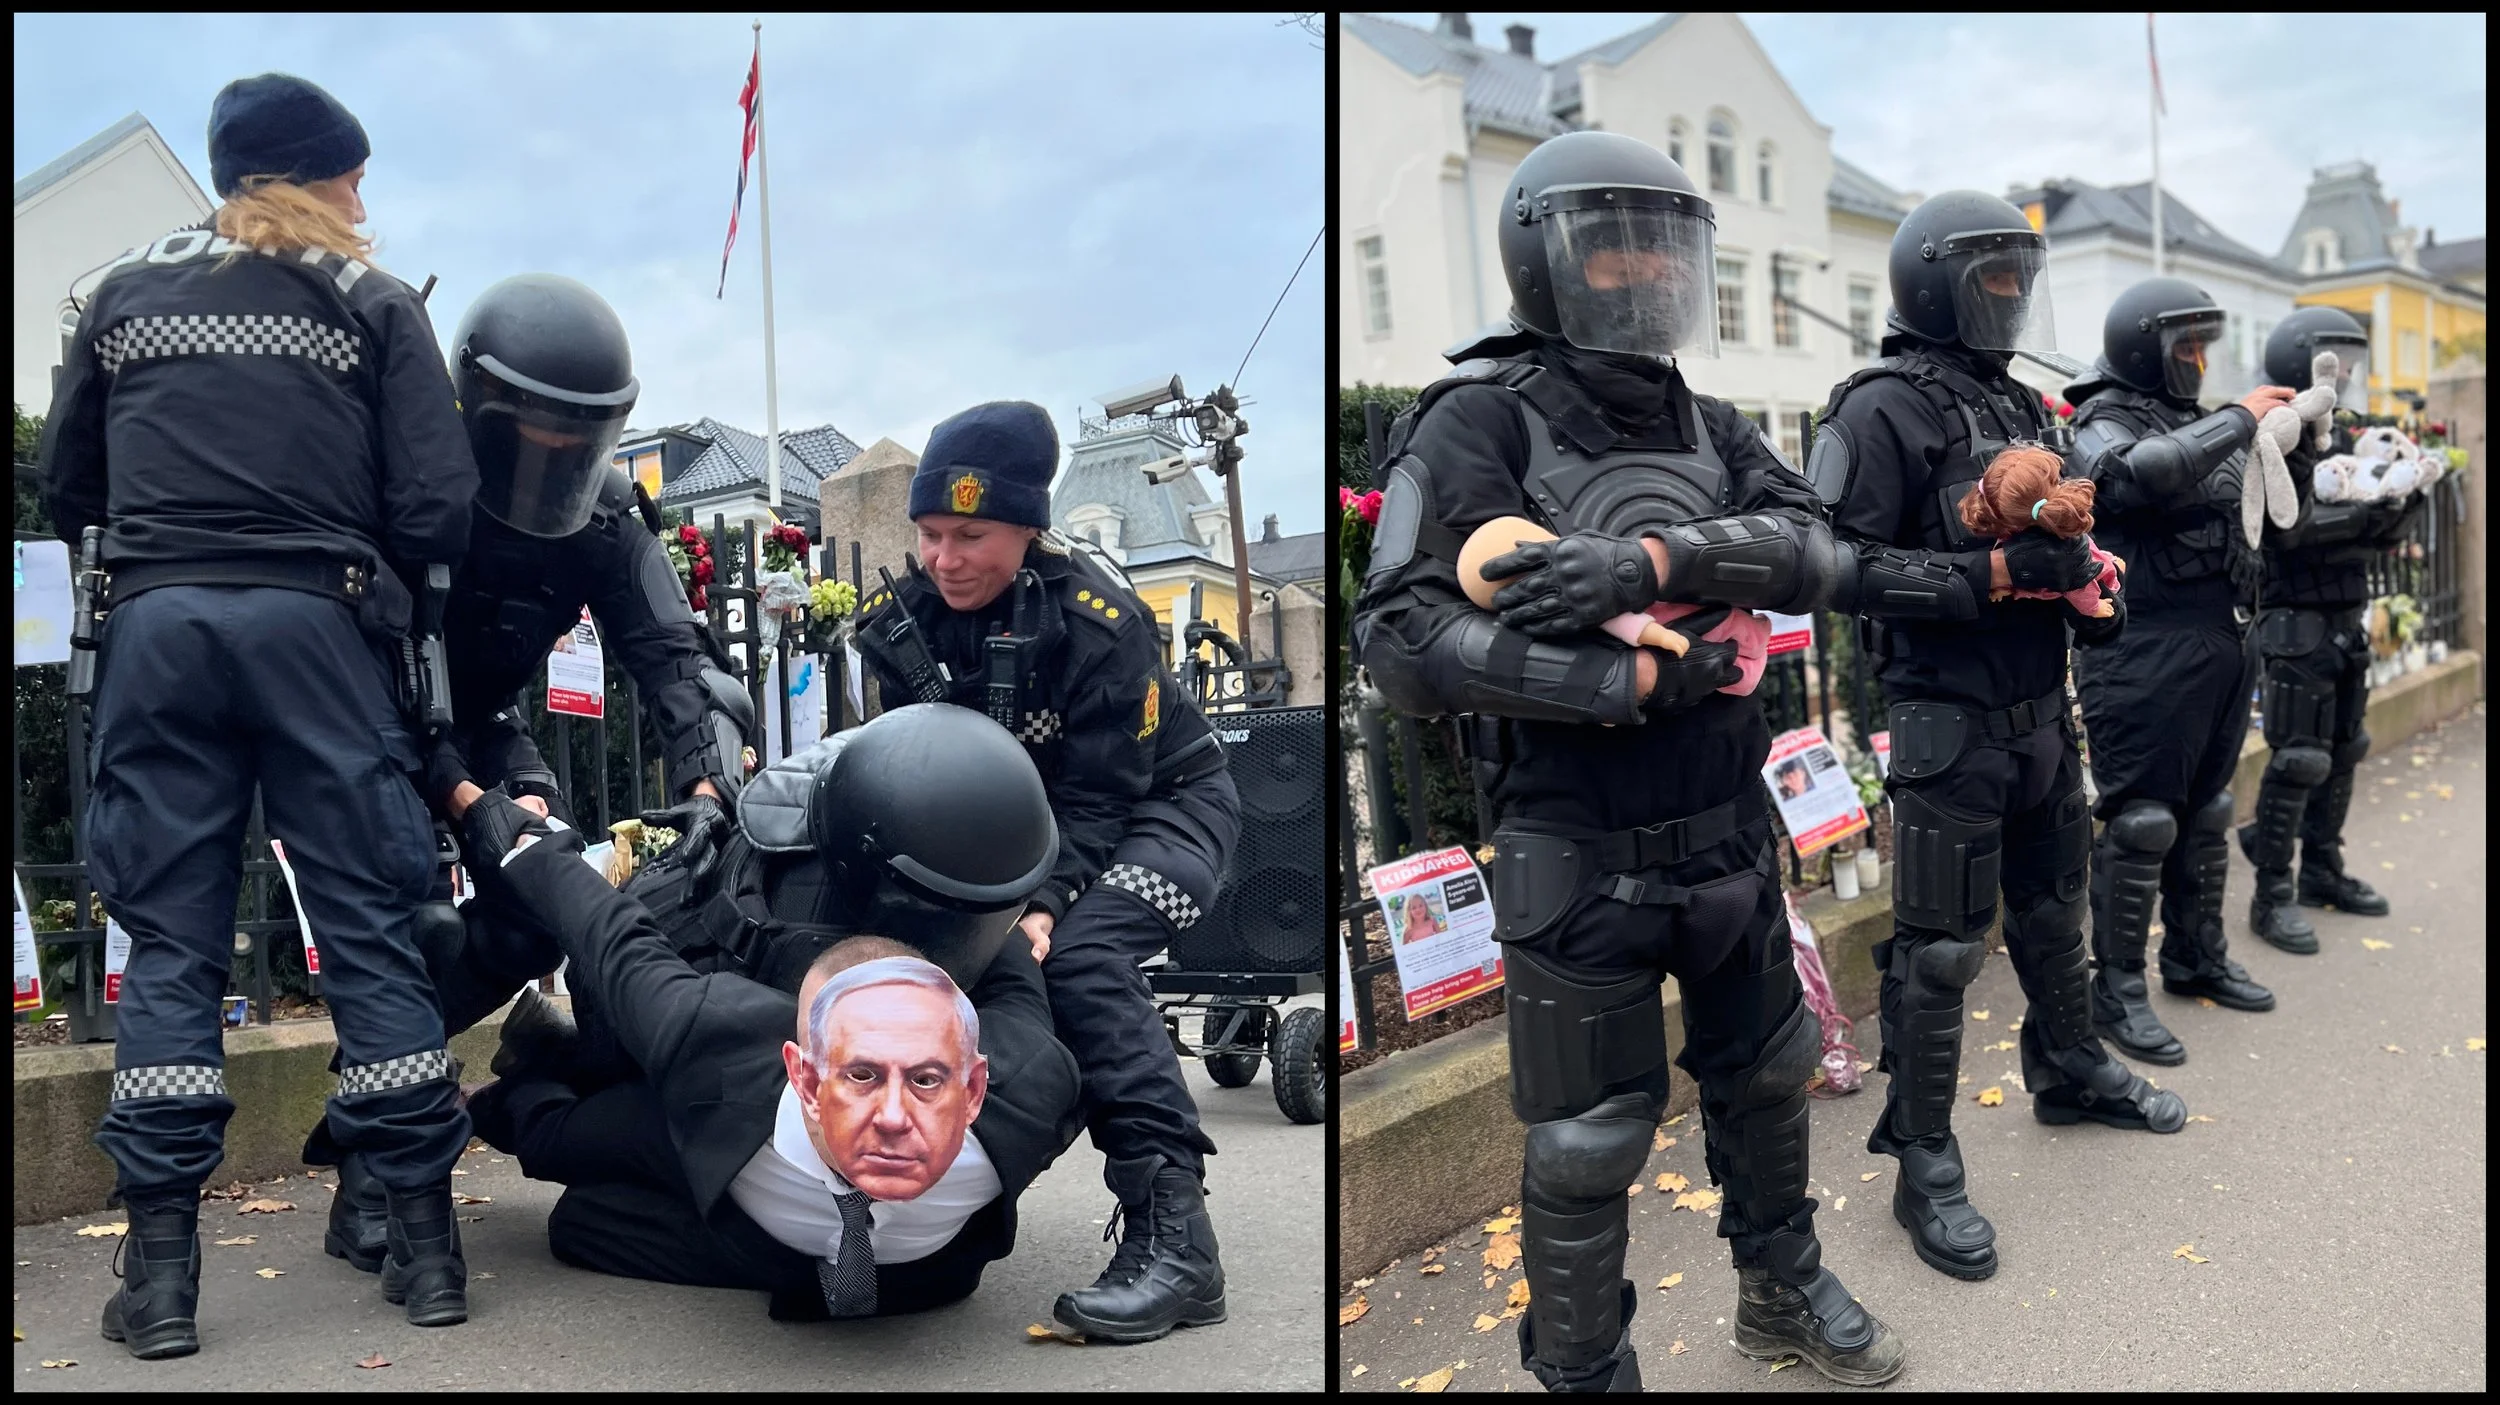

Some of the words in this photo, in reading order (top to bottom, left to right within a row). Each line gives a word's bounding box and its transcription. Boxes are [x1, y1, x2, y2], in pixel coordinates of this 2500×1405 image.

[1381, 852, 1466, 887] KIDNAPPED
[1411, 991, 1431, 1002] Please
[1431, 986, 1445, 994] help
[1444, 980, 1460, 989] bring
[1459, 974, 1475, 983] them
